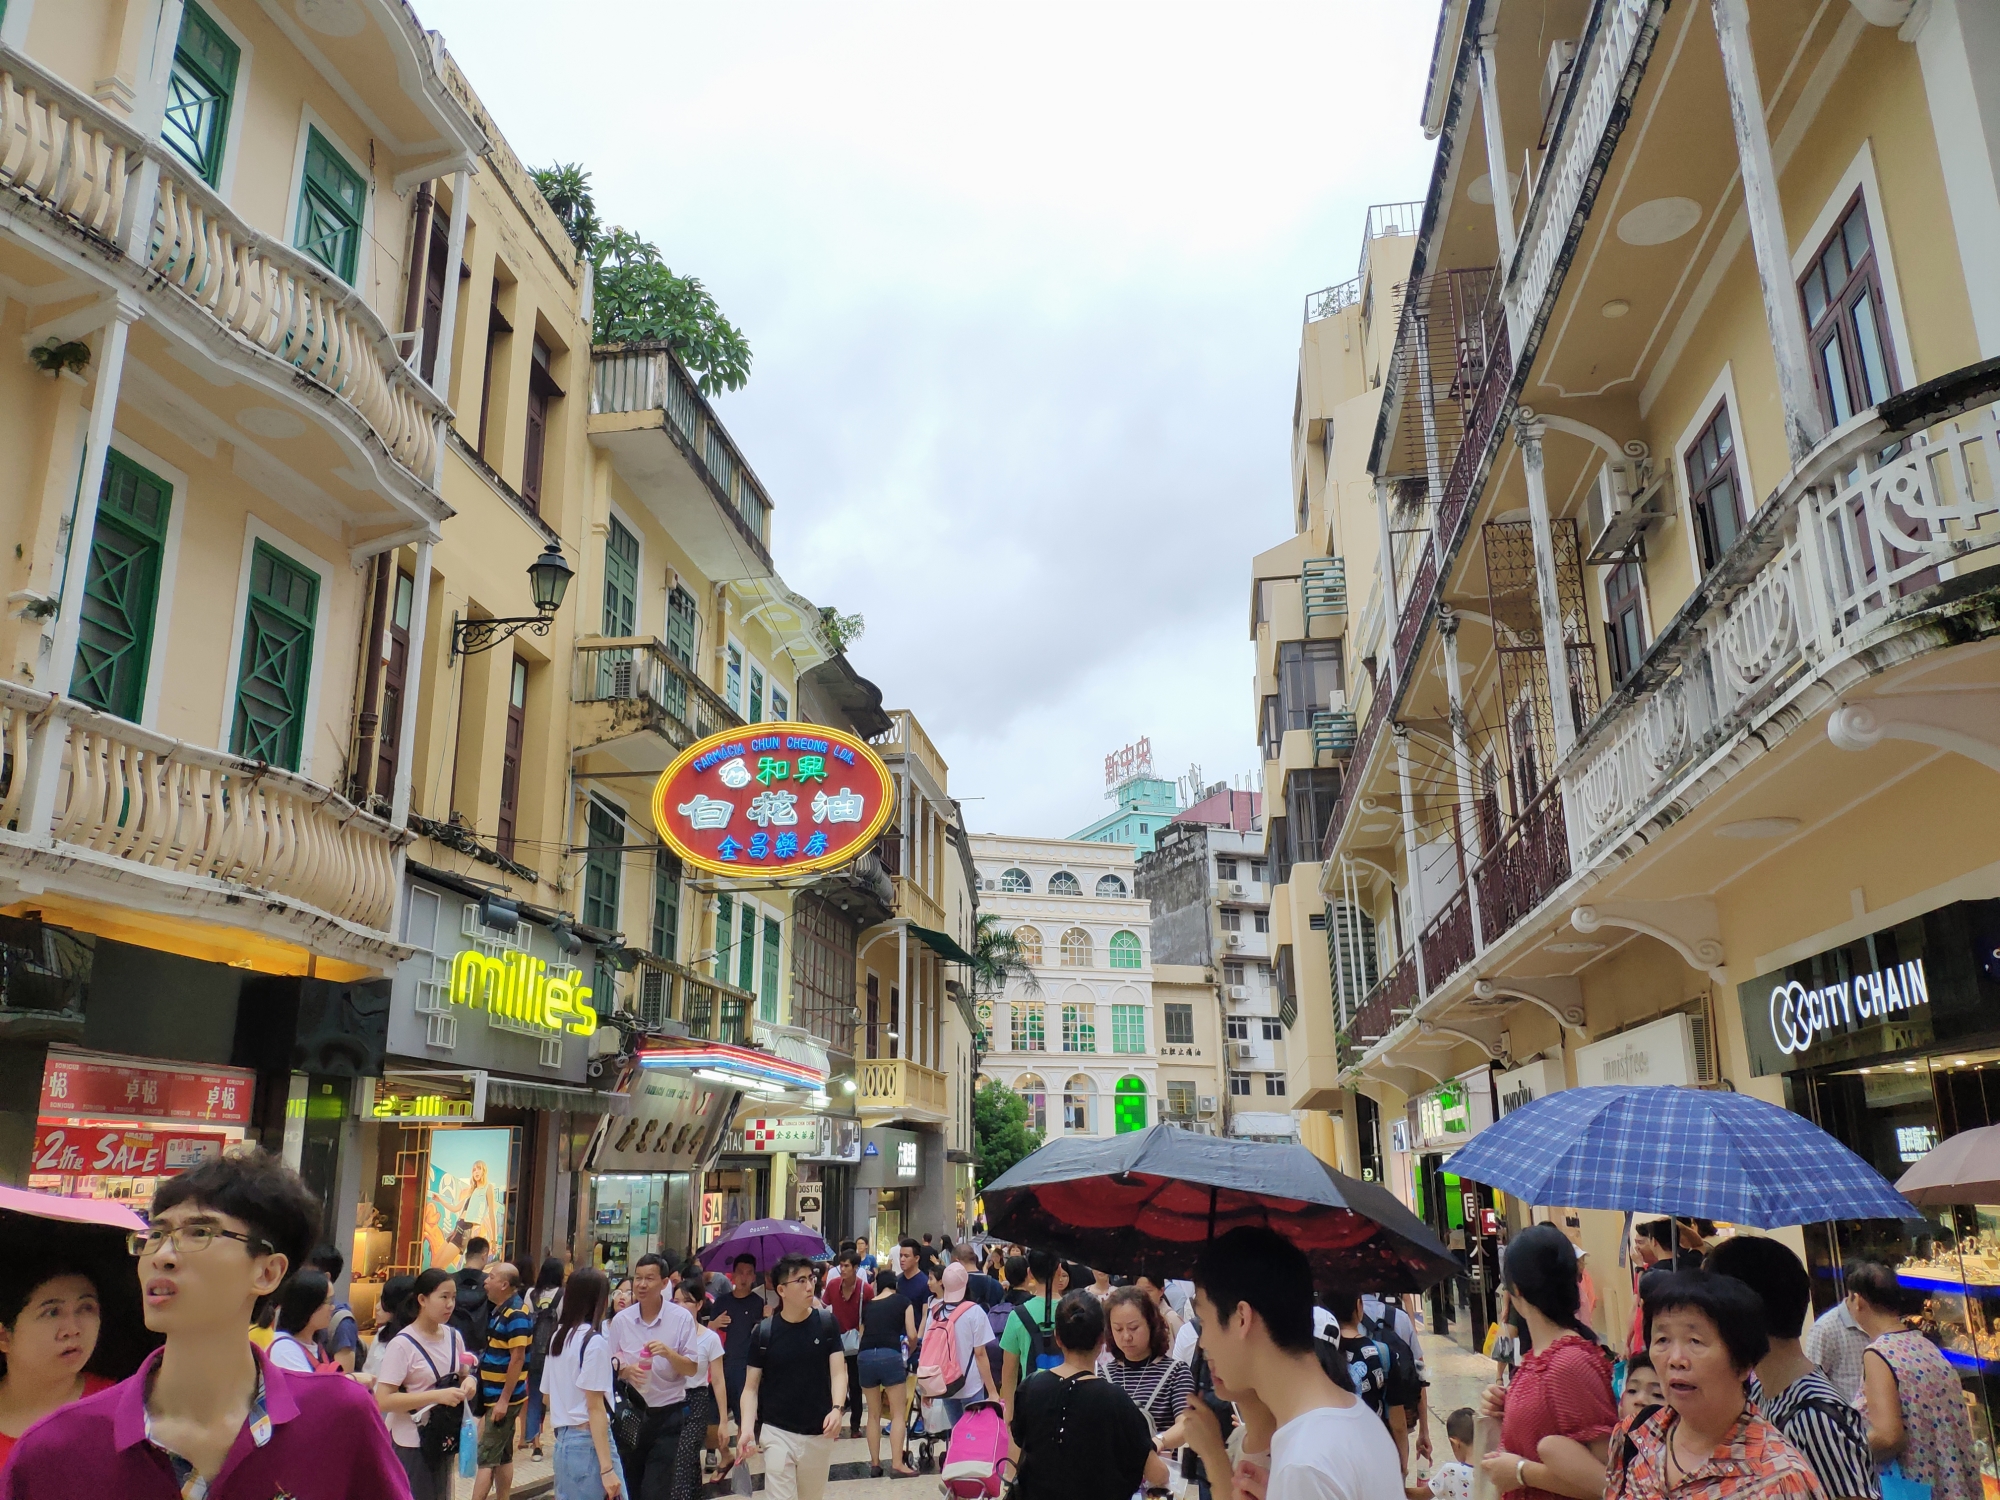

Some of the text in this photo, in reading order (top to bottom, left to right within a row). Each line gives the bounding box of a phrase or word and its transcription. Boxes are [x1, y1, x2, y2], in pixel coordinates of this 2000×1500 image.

[751, 737, 780, 751] CHUN
[786, 737, 828, 753] CHEONG
[1105, 735, 1150, 786] 新中央
[756, 755, 828, 786] 和興
[678, 787, 864, 830] 白花油
[717, 830, 829, 861] 全昌藥房
[450, 950, 597, 1036] millie's
[1808, 958, 1929, 1031] CITY CHAIN
[92, 1133, 160, 1173] SALE
